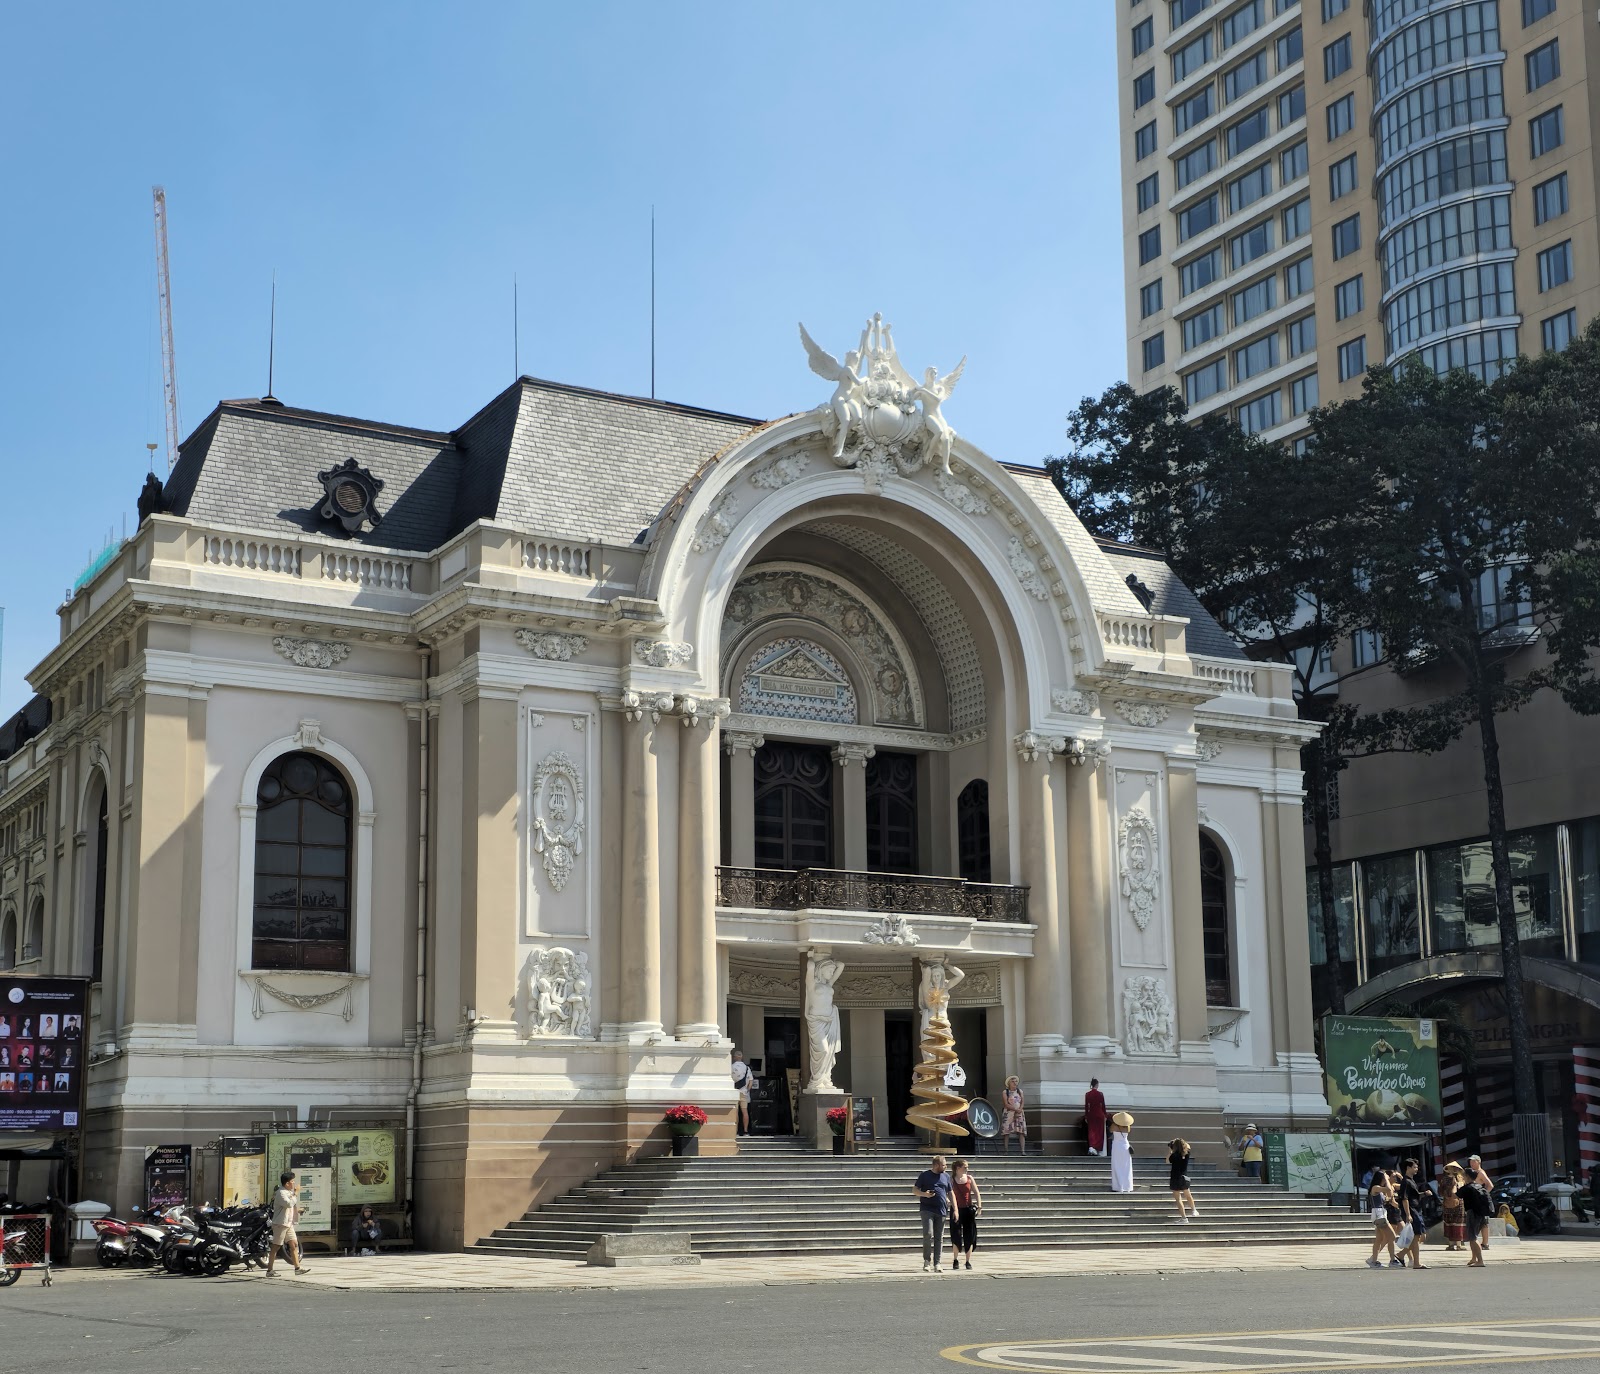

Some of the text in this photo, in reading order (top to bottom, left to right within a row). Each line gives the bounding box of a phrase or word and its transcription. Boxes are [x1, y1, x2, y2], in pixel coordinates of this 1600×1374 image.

[1362, 1055, 1409, 1075] Vietnamese
[1343, 1066, 1427, 1091] Bamboo Circus
